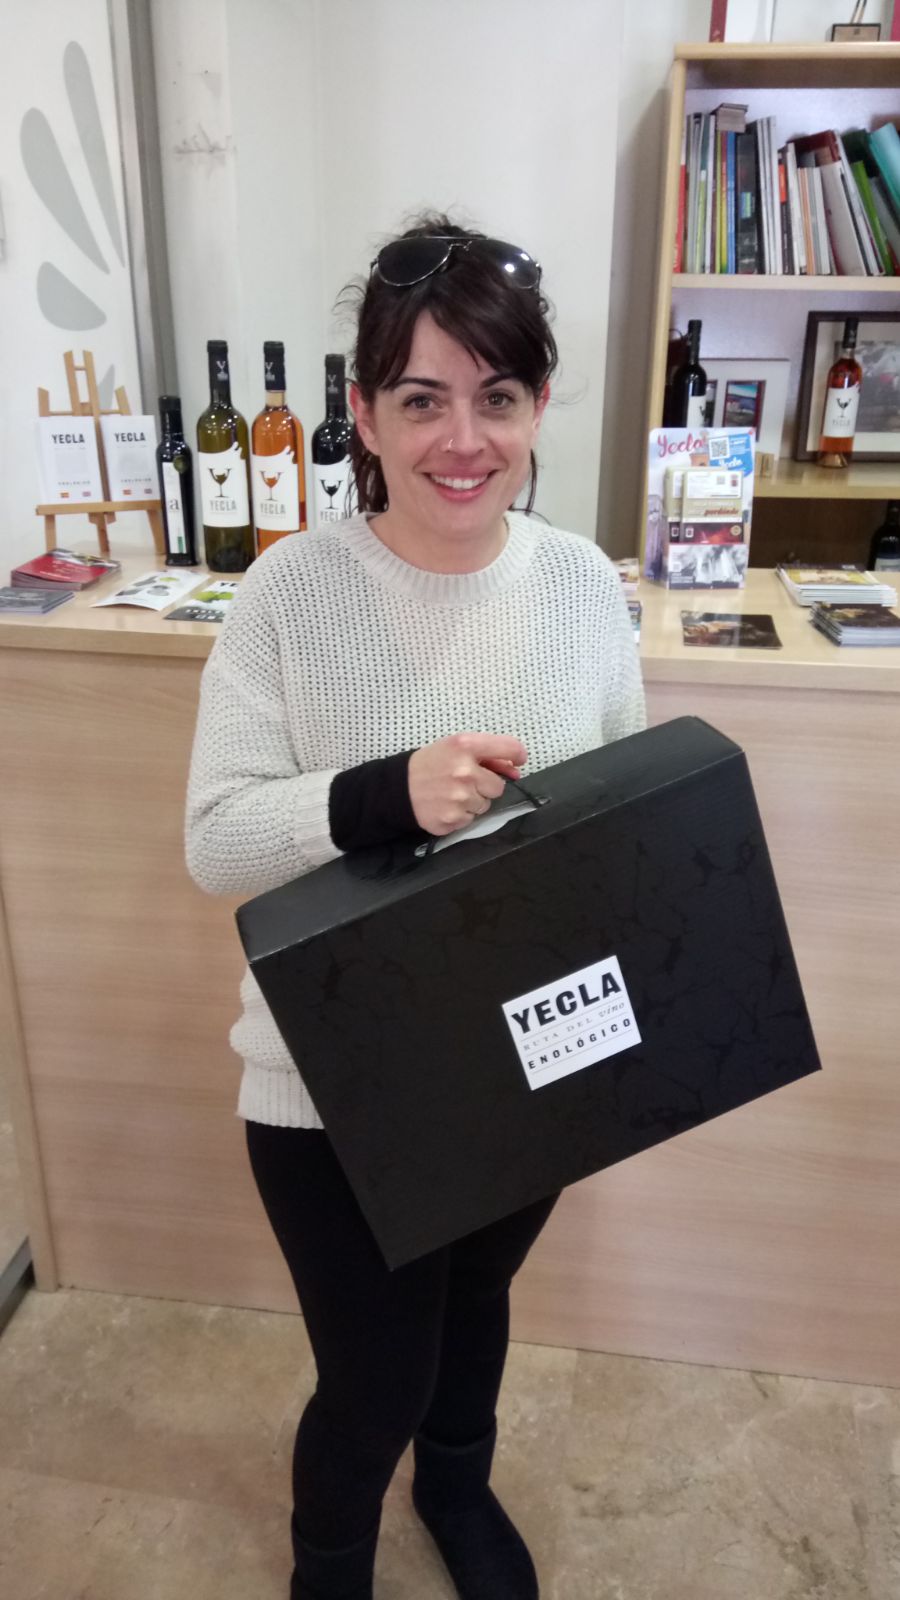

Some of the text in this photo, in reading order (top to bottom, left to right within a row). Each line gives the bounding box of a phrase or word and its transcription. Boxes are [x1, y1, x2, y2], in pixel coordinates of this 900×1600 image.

[51, 433, 86, 444] YECLA
[114, 431, 147, 442] YECLA
[209, 499, 237, 512] YECLA
[260, 502, 287, 515] YECLA
[511, 971, 622, 1034] YECLA
[523, 1032, 560, 1051] RUTA
[566, 1017, 593, 1032] DEL
[528, 1017, 631, 1069] ENOLÓGICO
